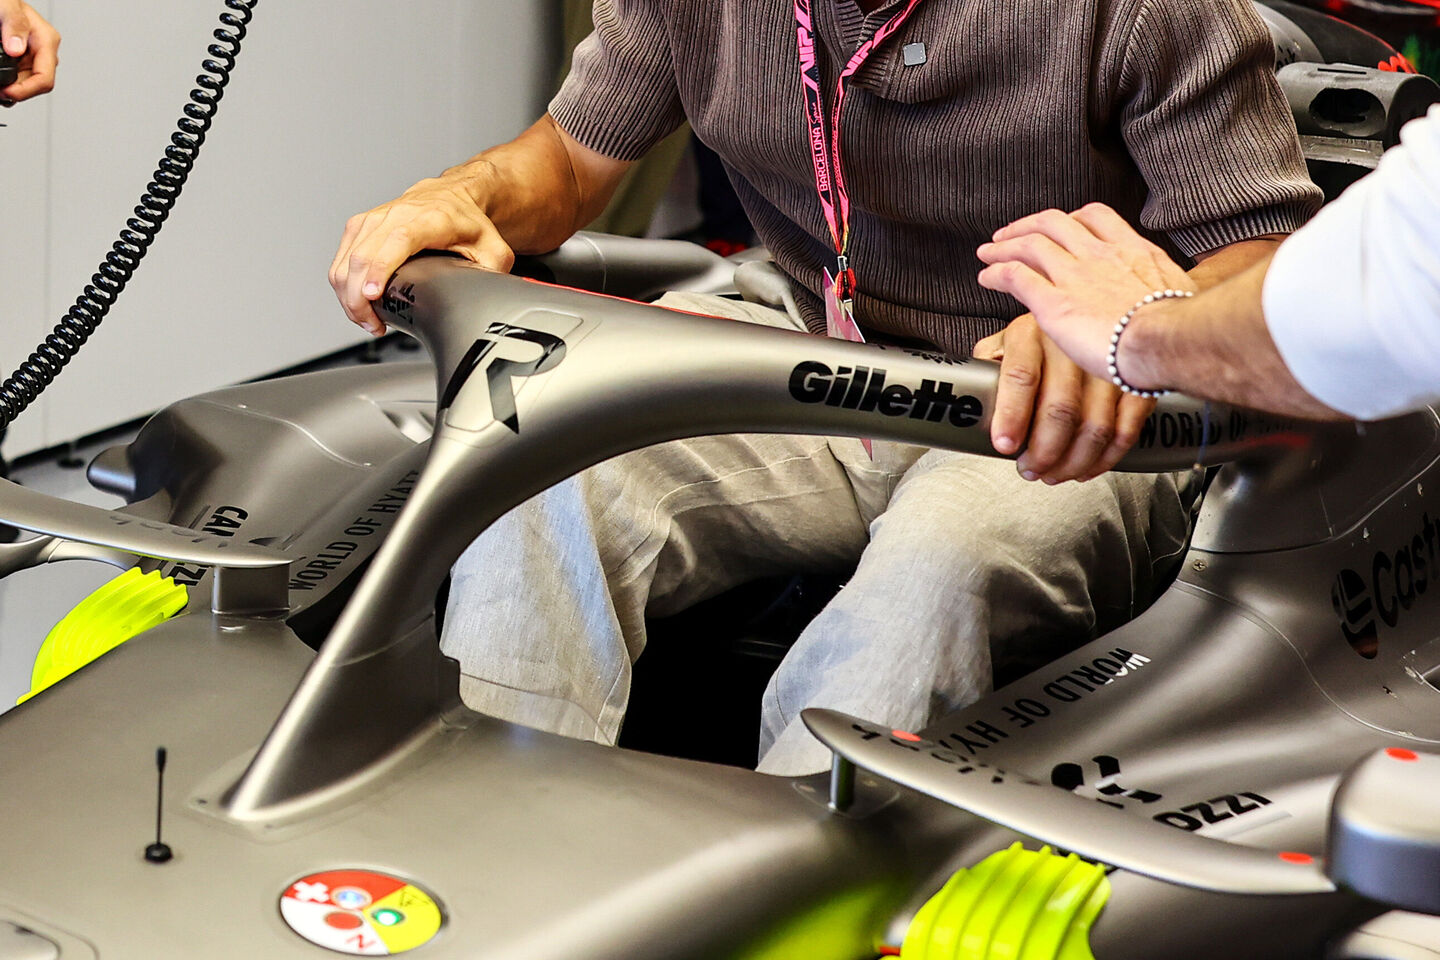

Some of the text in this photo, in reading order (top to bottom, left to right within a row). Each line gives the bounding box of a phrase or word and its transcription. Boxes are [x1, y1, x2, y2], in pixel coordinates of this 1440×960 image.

[812, 126, 829, 192] BARCELONA
[788, 360, 984, 428] Gillette
[288, 541, 359, 590] WORLD
[344, 516, 383, 536] OF
[1001, 647, 1152, 729] WORLD OF
